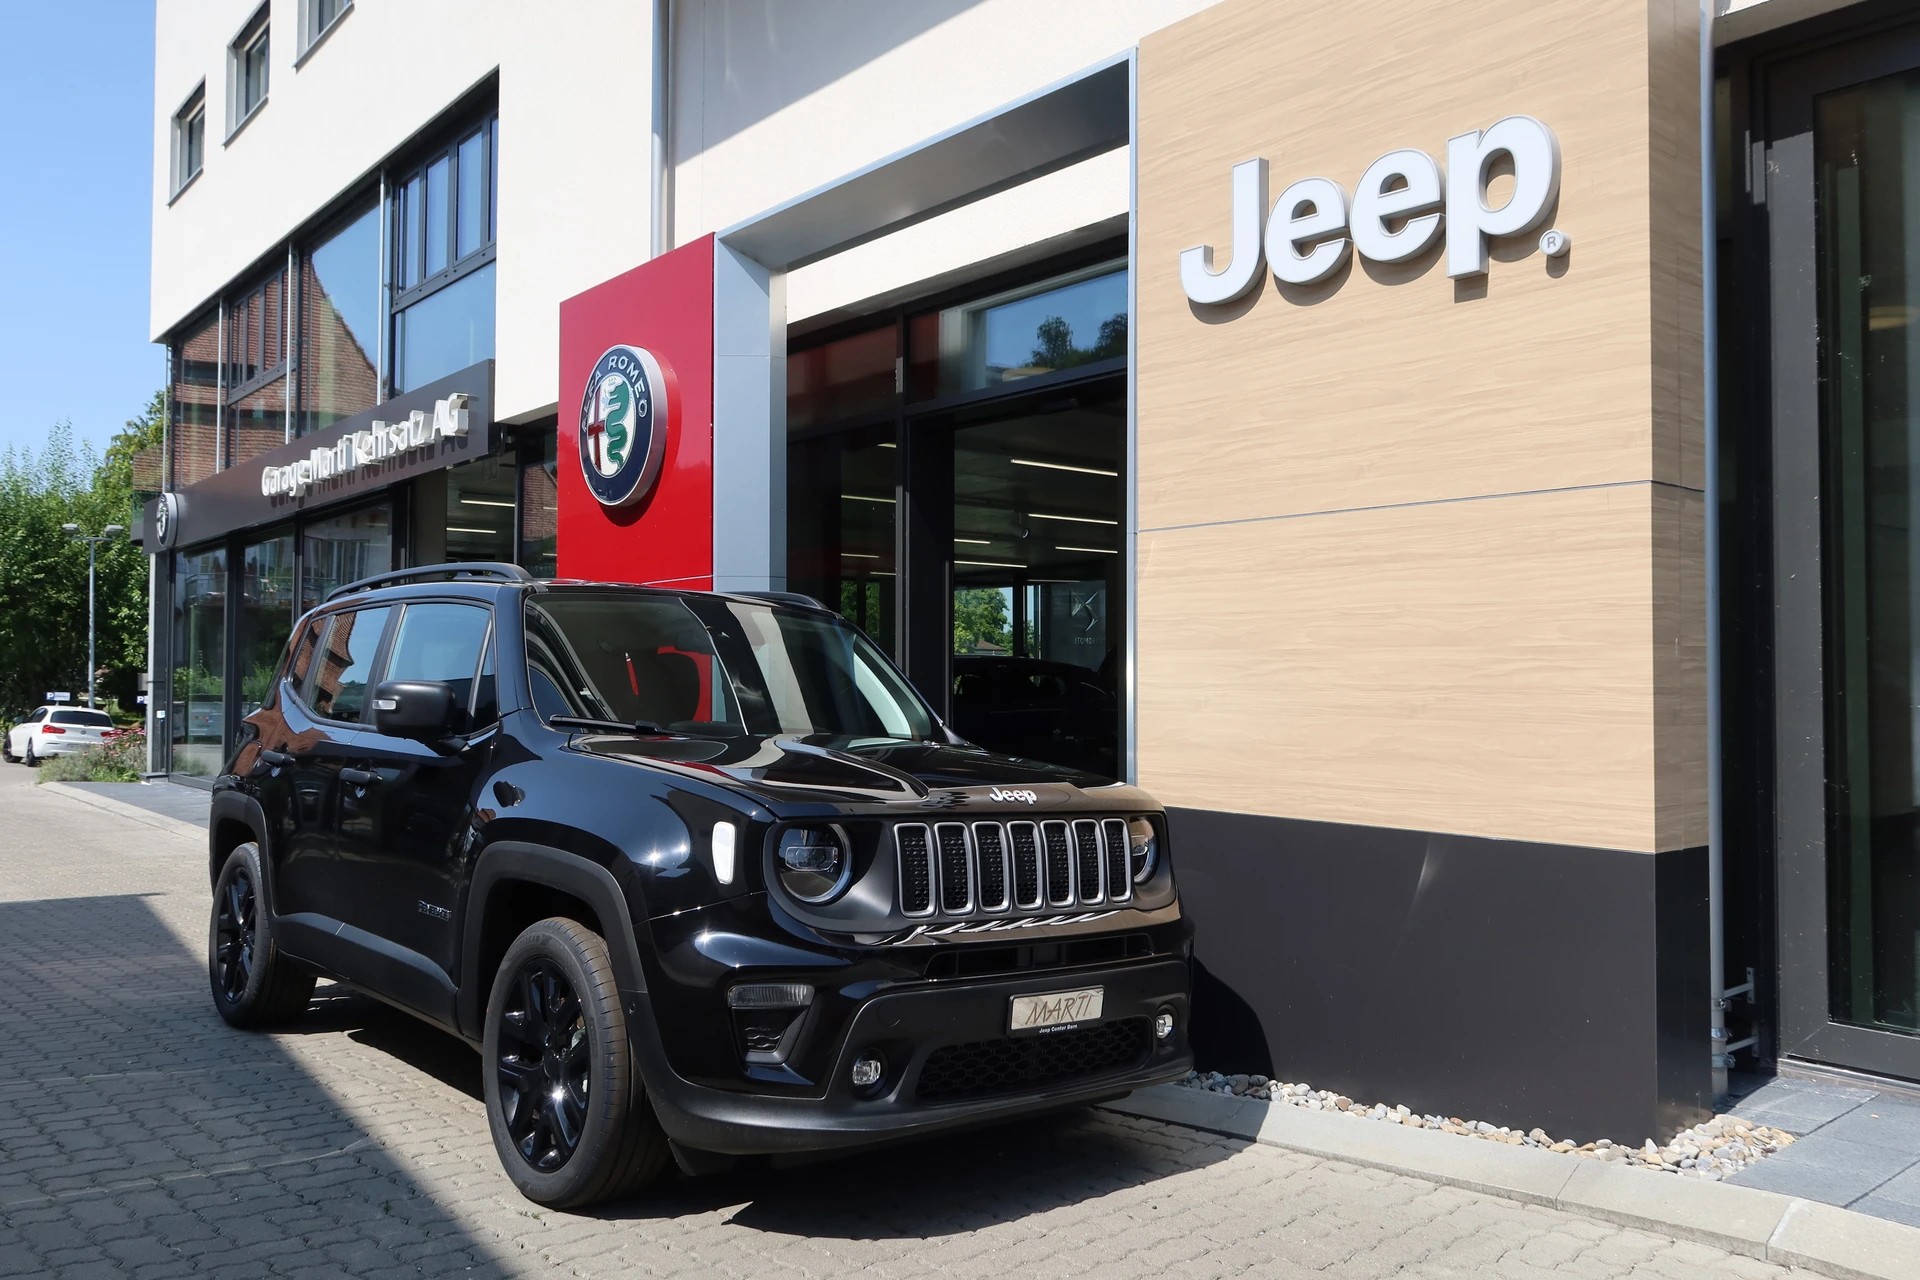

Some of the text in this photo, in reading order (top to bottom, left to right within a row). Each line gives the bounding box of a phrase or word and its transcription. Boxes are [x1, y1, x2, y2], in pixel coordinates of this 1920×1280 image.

[1179, 114, 1560, 304] Jeep
[581, 355, 648, 433] ALFA ROMEO
[261, 393, 469, 497] Garage Marti Kehrsatz AG
[989, 786, 1038, 805] Jeep
[1025, 995, 1092, 1025] MARTI
